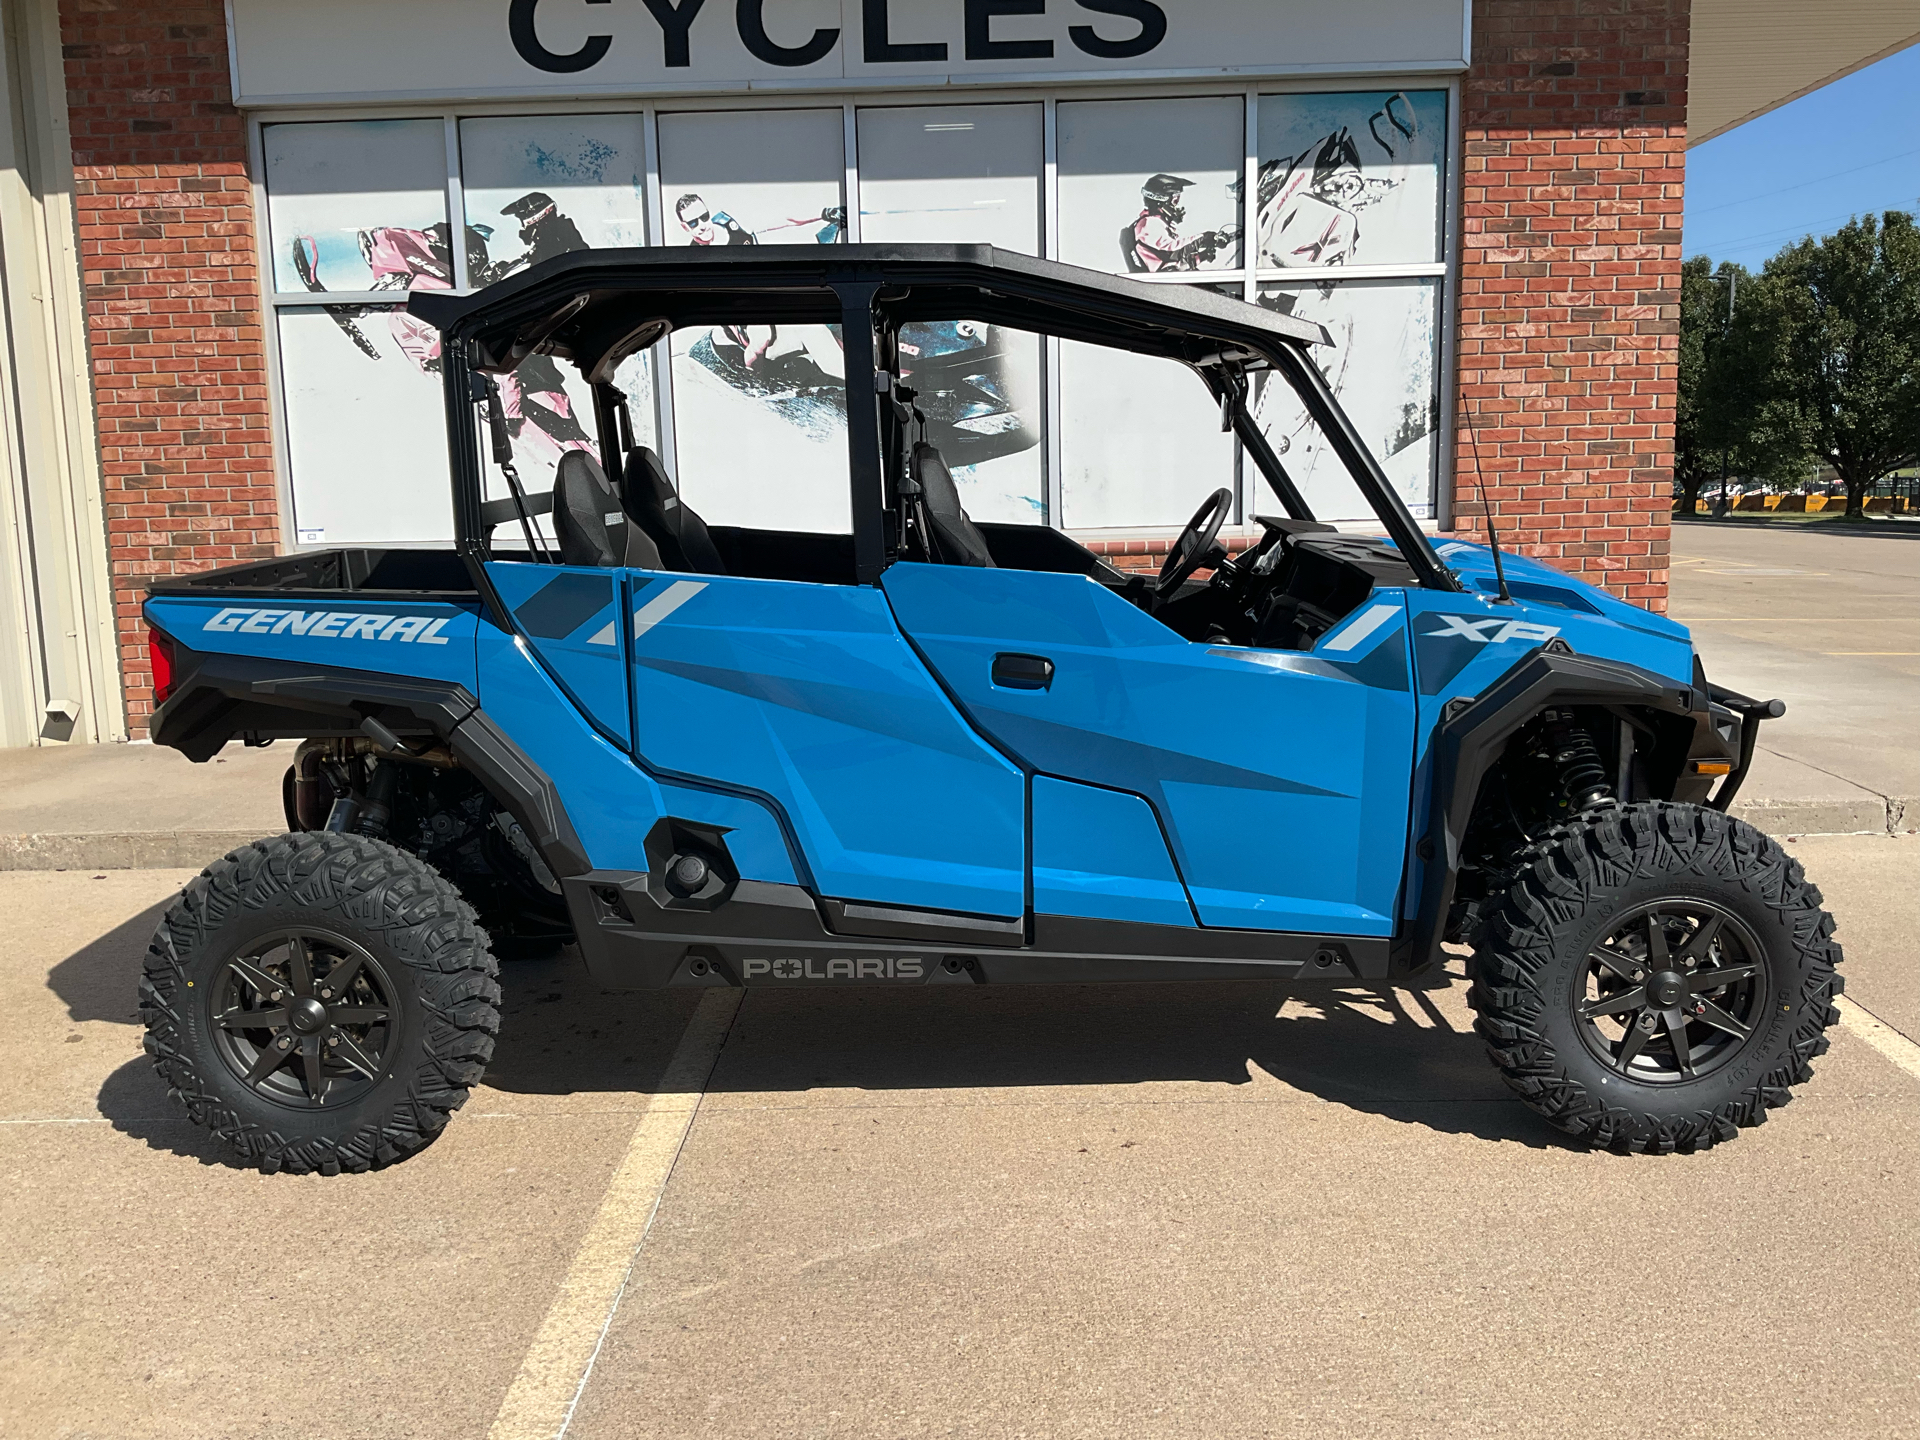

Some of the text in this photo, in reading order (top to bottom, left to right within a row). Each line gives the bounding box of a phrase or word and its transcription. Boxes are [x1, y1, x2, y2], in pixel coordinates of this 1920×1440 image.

[508, 0, 1167, 73] CYCLES
[202, 607, 450, 645] GENERAL
[1419, 614, 1562, 644] XP
[742, 958, 924, 979] POLARIS
